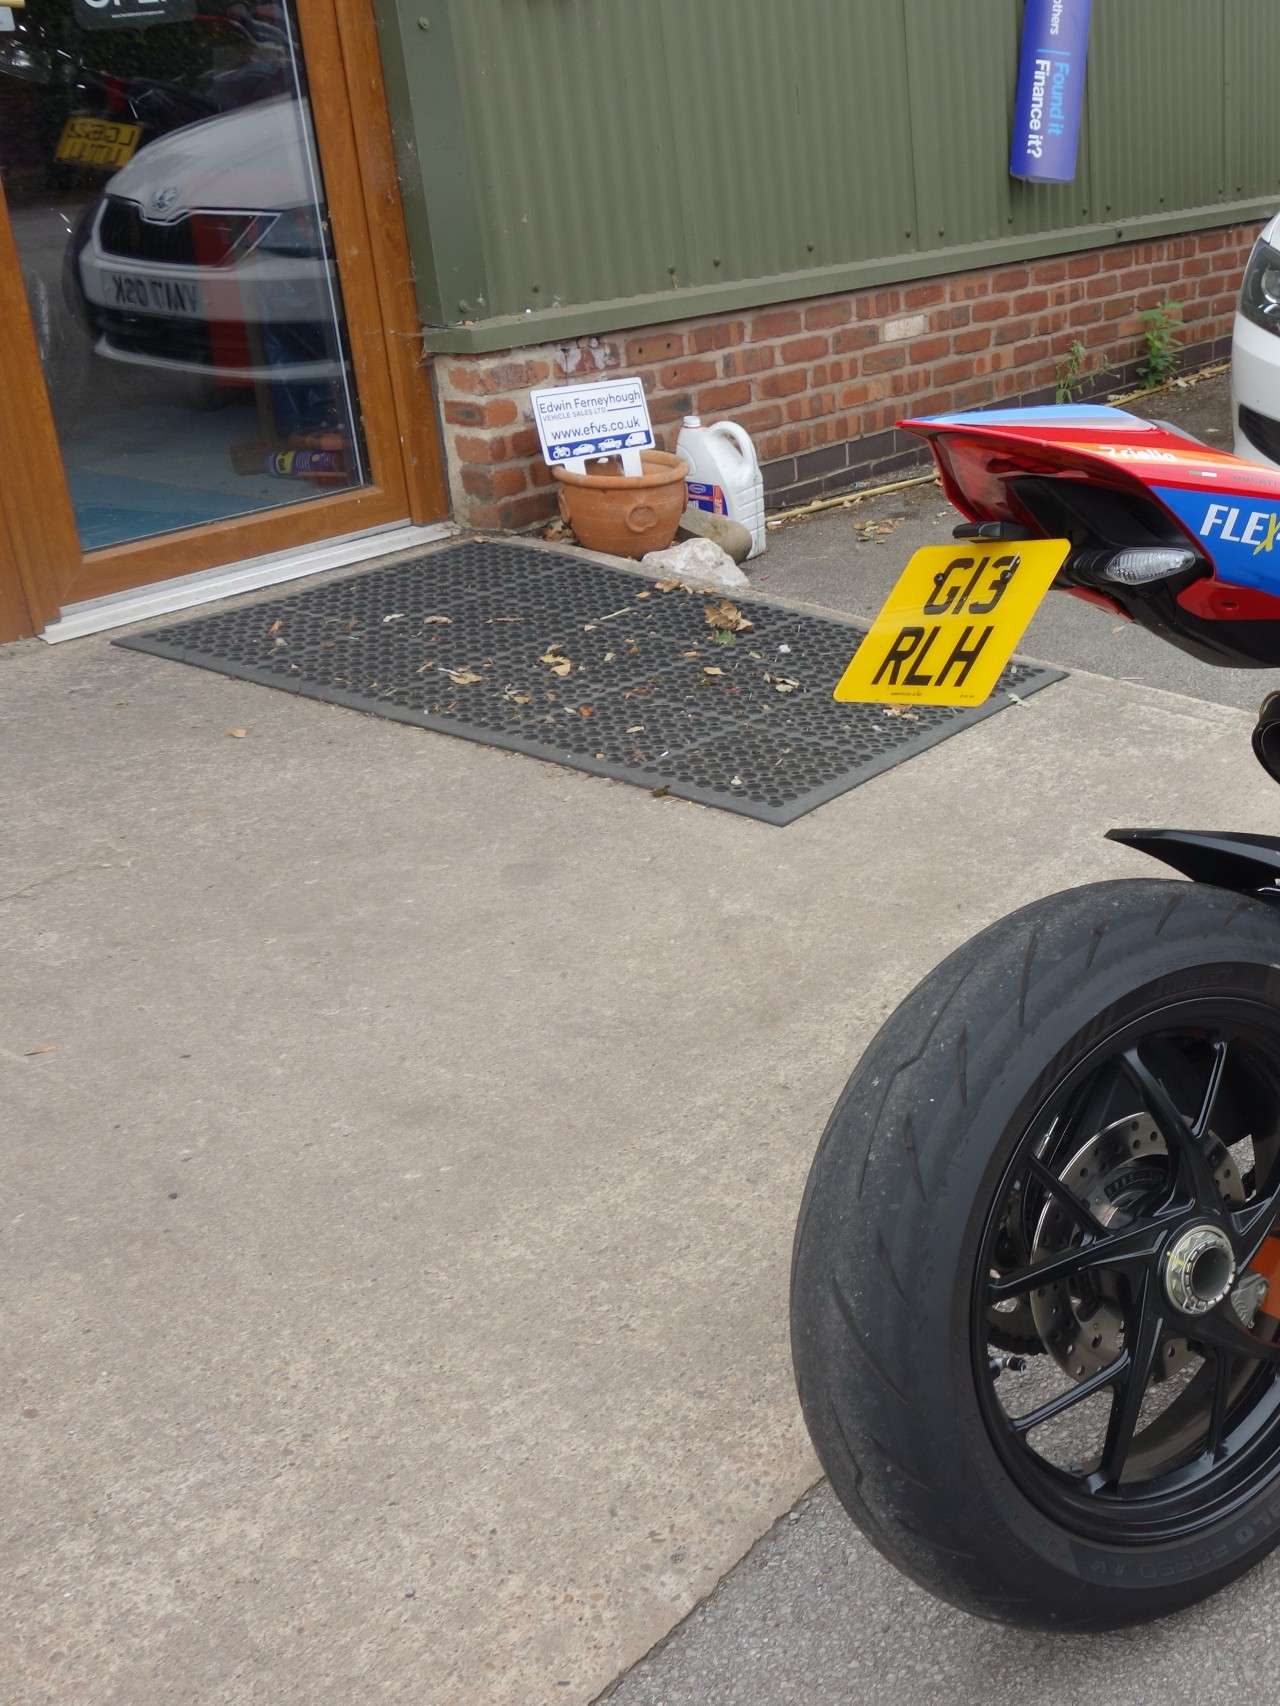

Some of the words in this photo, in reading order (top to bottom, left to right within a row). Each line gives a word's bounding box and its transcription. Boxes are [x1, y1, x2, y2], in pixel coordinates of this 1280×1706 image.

[1029, 58, 1051, 131] Finance
[1049, 61, 1070, 120] Found
[1048, 123, 1064, 136] it
[1026, 133, 1044, 159] it?
[540, 398, 573, 414] Edwin
[574, 390, 641, 408] Ferneyhough
[552, 416, 640, 440] www.efvs.co.uk
[871, 626, 994, 687] RLH
